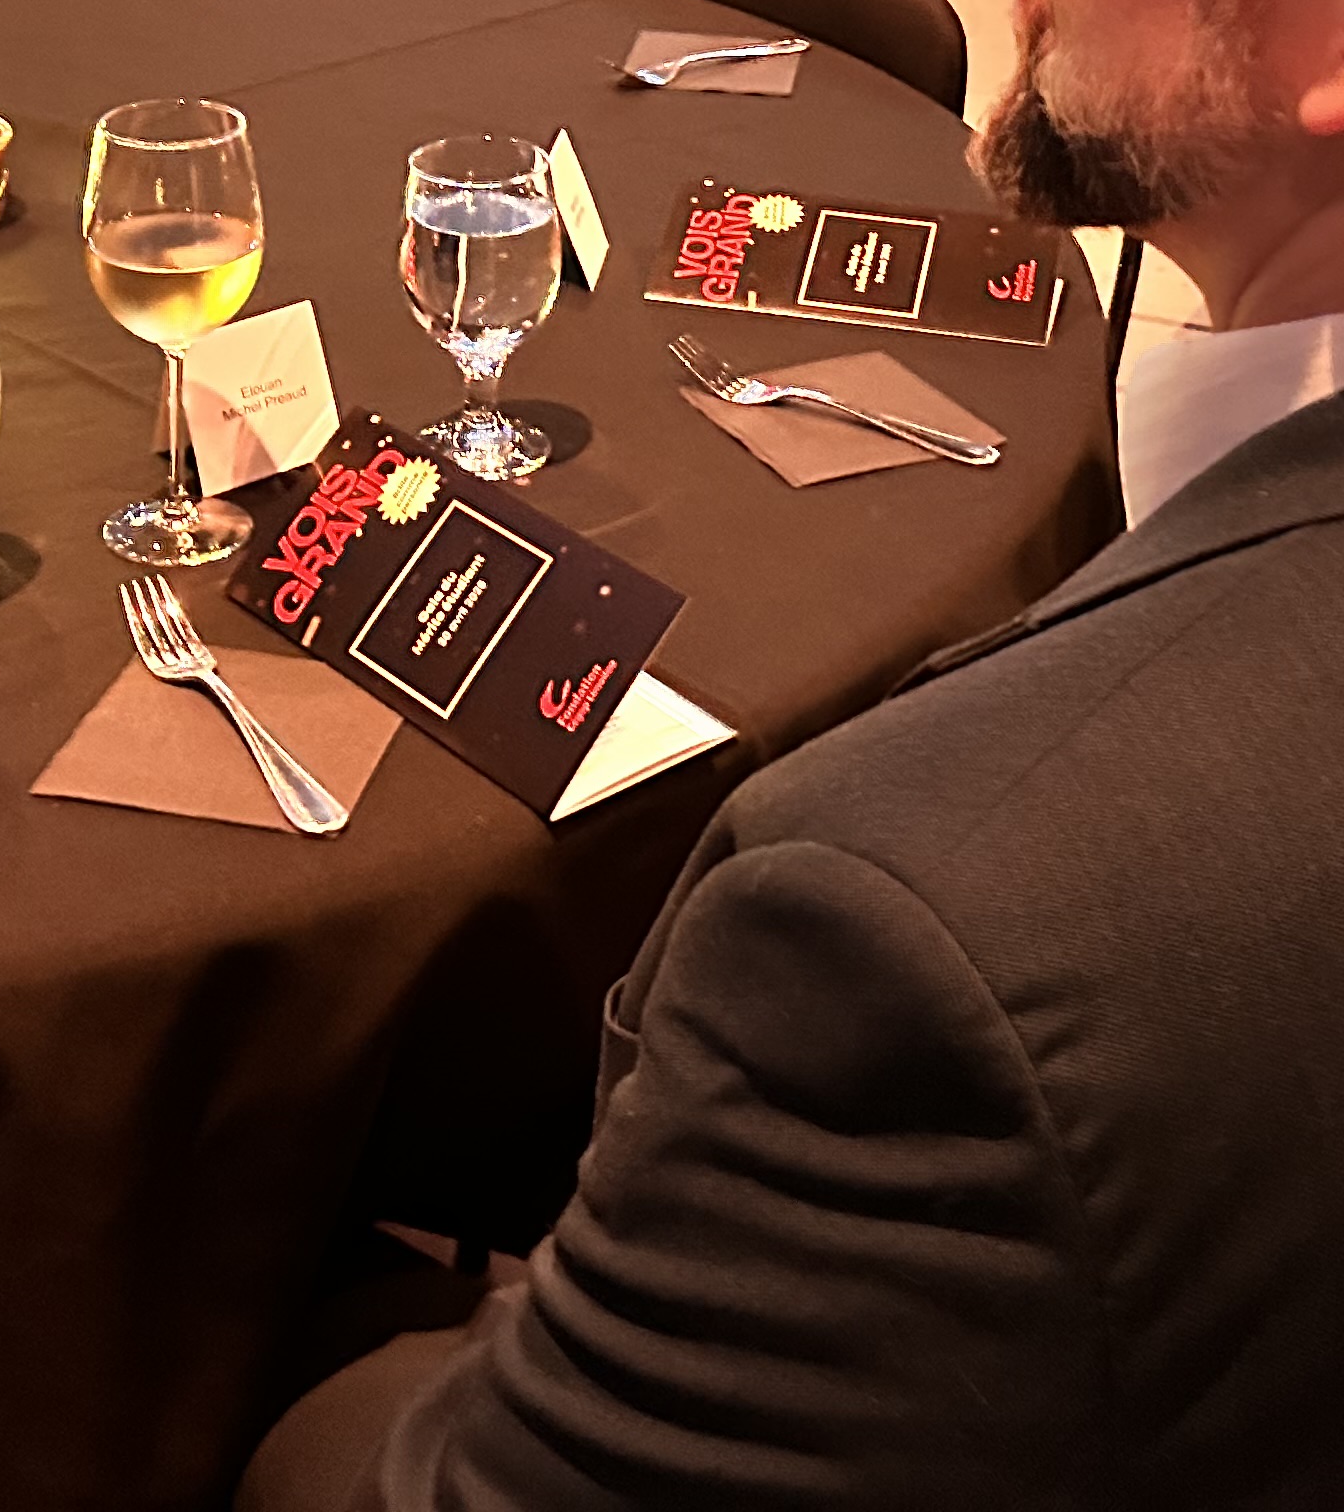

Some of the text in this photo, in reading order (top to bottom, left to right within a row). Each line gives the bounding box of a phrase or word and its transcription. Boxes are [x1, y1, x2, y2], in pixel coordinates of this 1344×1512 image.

[673, 209, 724, 278] VOIS
[700, 193, 761, 303] GRAND
[262, 463, 358, 572] VOIS
[273, 449, 405, 625] GRAND
[417, 570, 458, 624] Gala du
[448, 605, 469, 633] avril
[411, 609, 446, 656] Mérite
[556, 663, 602, 728] Fondation
